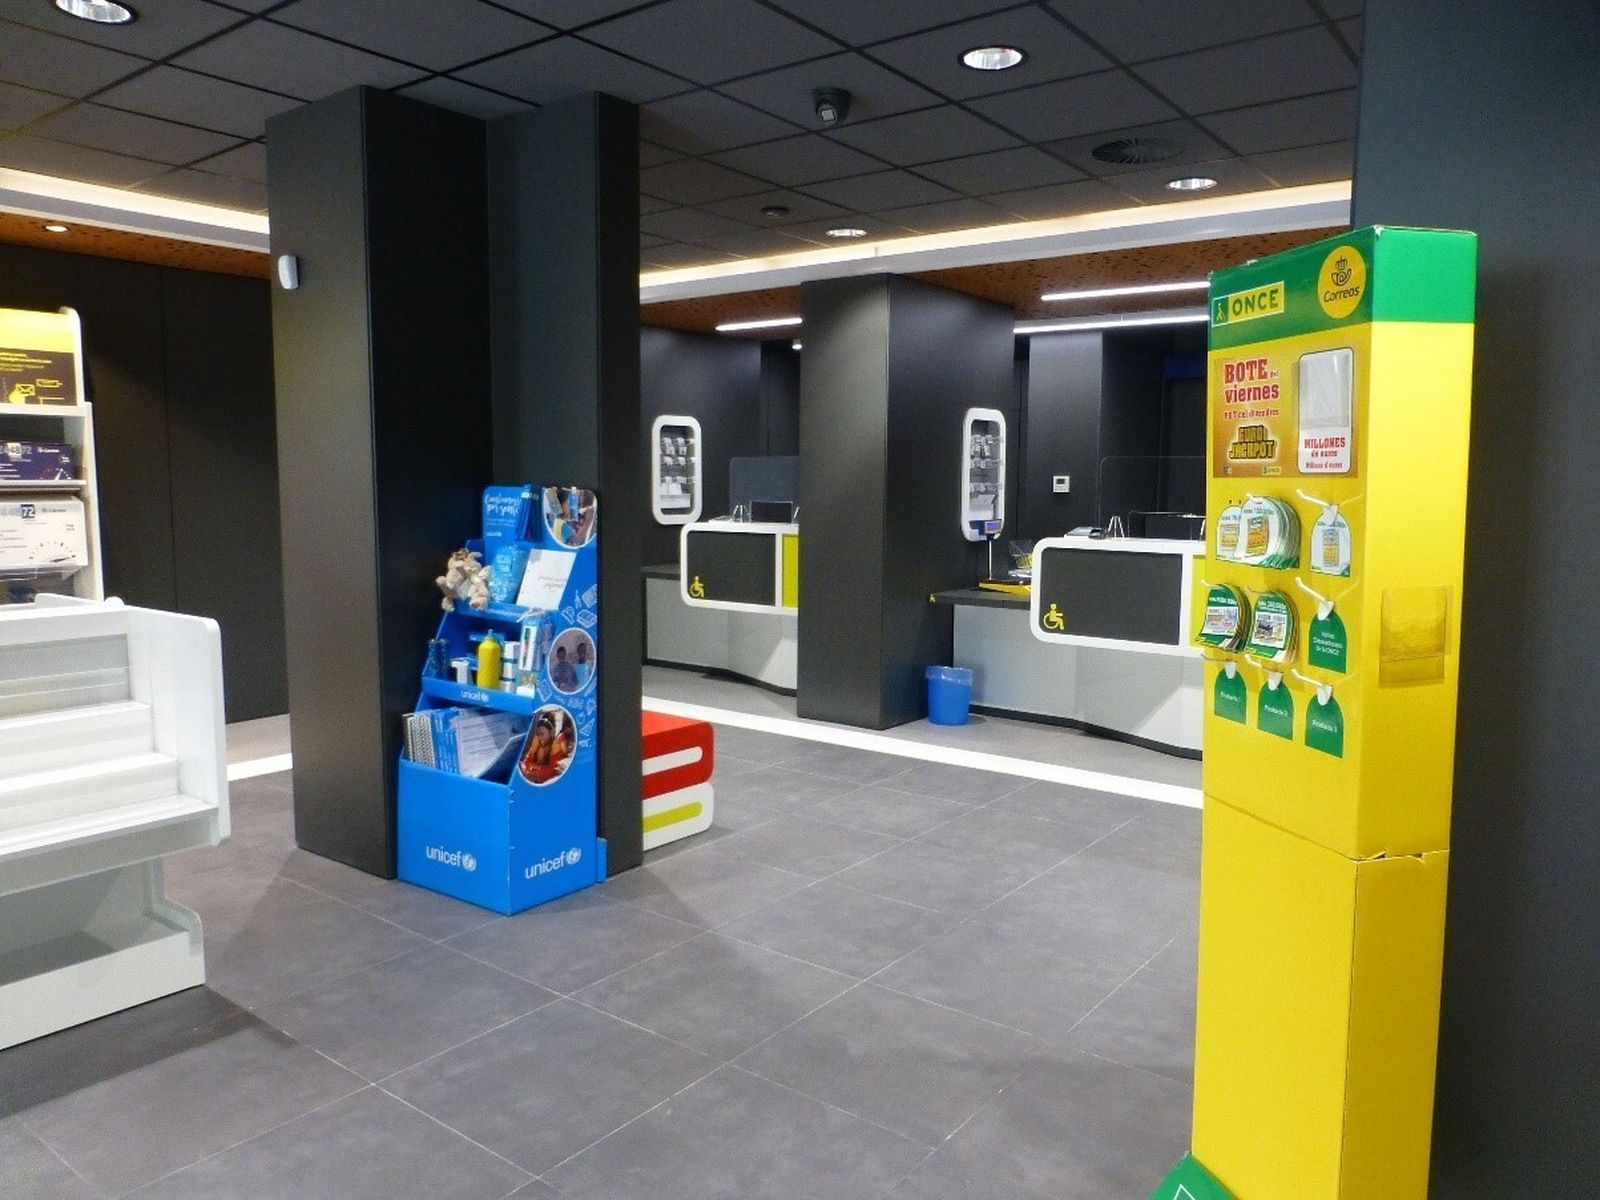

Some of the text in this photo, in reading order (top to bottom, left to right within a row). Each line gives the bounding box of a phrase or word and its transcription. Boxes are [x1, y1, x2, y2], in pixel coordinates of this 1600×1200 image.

[1231, 288, 1279, 317] ONCE
[1323, 286, 1360, 303] Correos
[1224, 358, 1268, 384] BOTE
[1224, 384, 1279, 404] viernes
[1229, 440, 1275, 460] JACKPOT
[1304, 437, 1346, 449] MILLONES
[22, 507, 35, 518] 72
[460, 690, 480, 699] unicef
[426, 845, 464, 868] unicef
[525, 852, 567, 880] unicef
